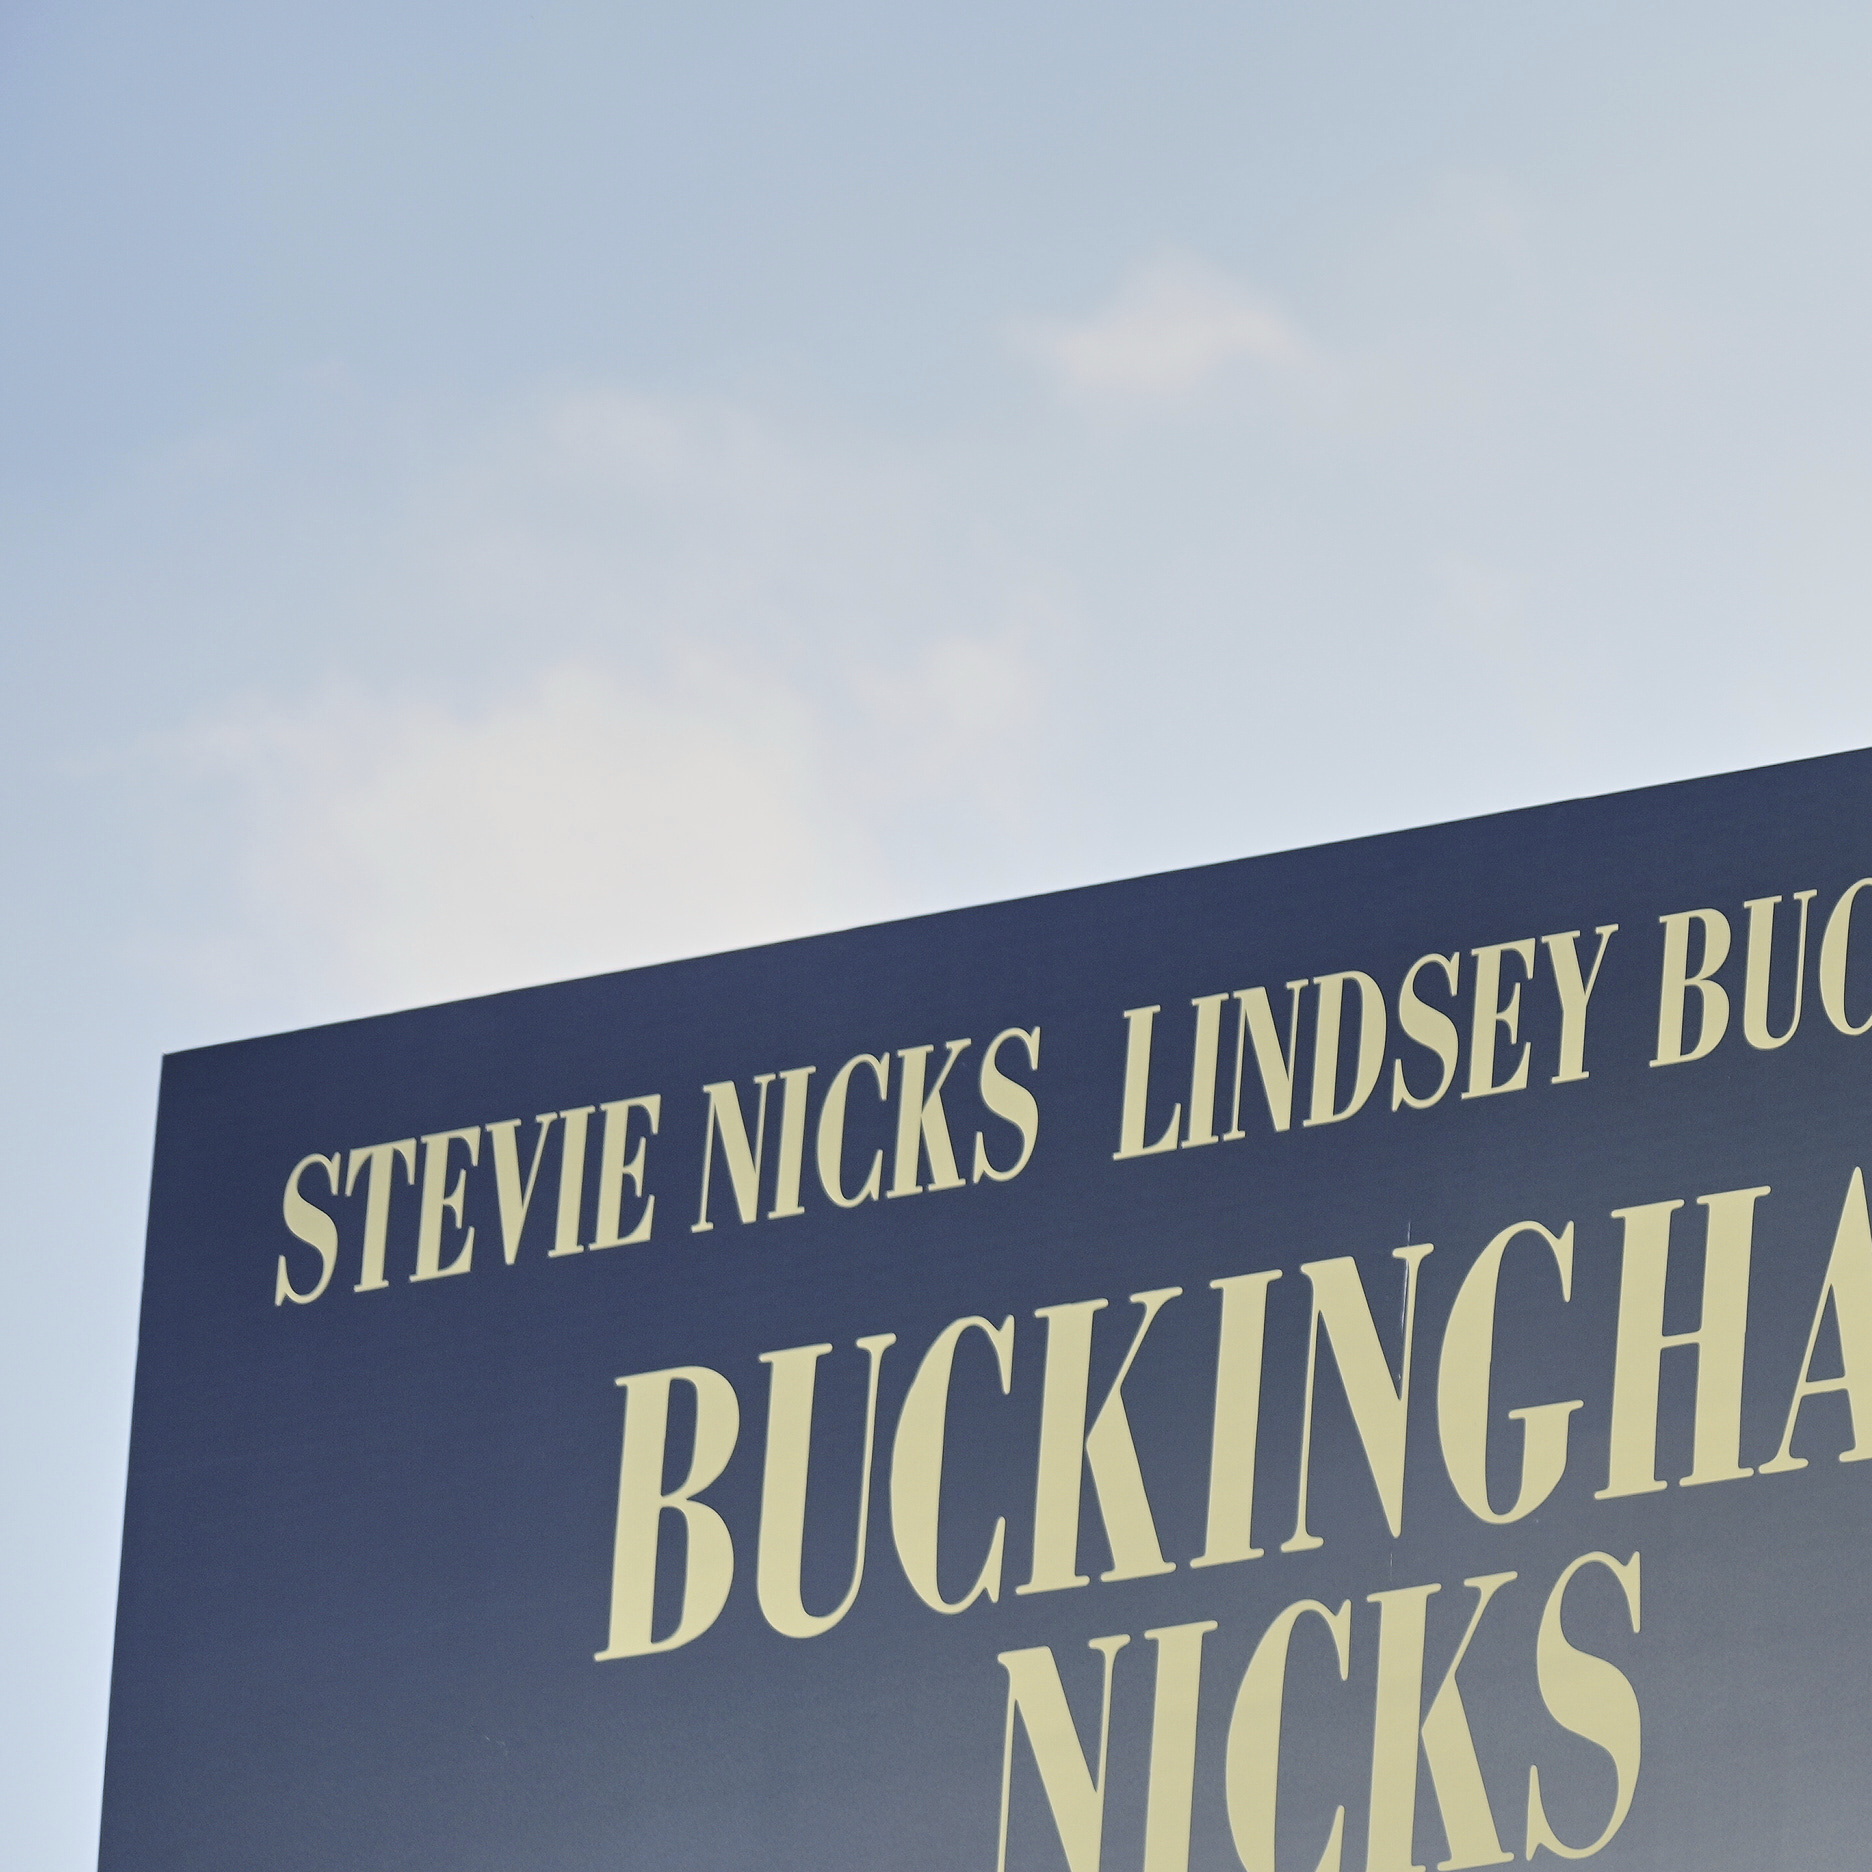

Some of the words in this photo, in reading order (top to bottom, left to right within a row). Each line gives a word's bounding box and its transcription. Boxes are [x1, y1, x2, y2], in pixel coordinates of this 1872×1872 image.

[275, 1093, 663, 1307] STEVIE
[690, 1026, 1042, 1235] NICKS
[1113, 923, 1619, 1161] LINDSEY
